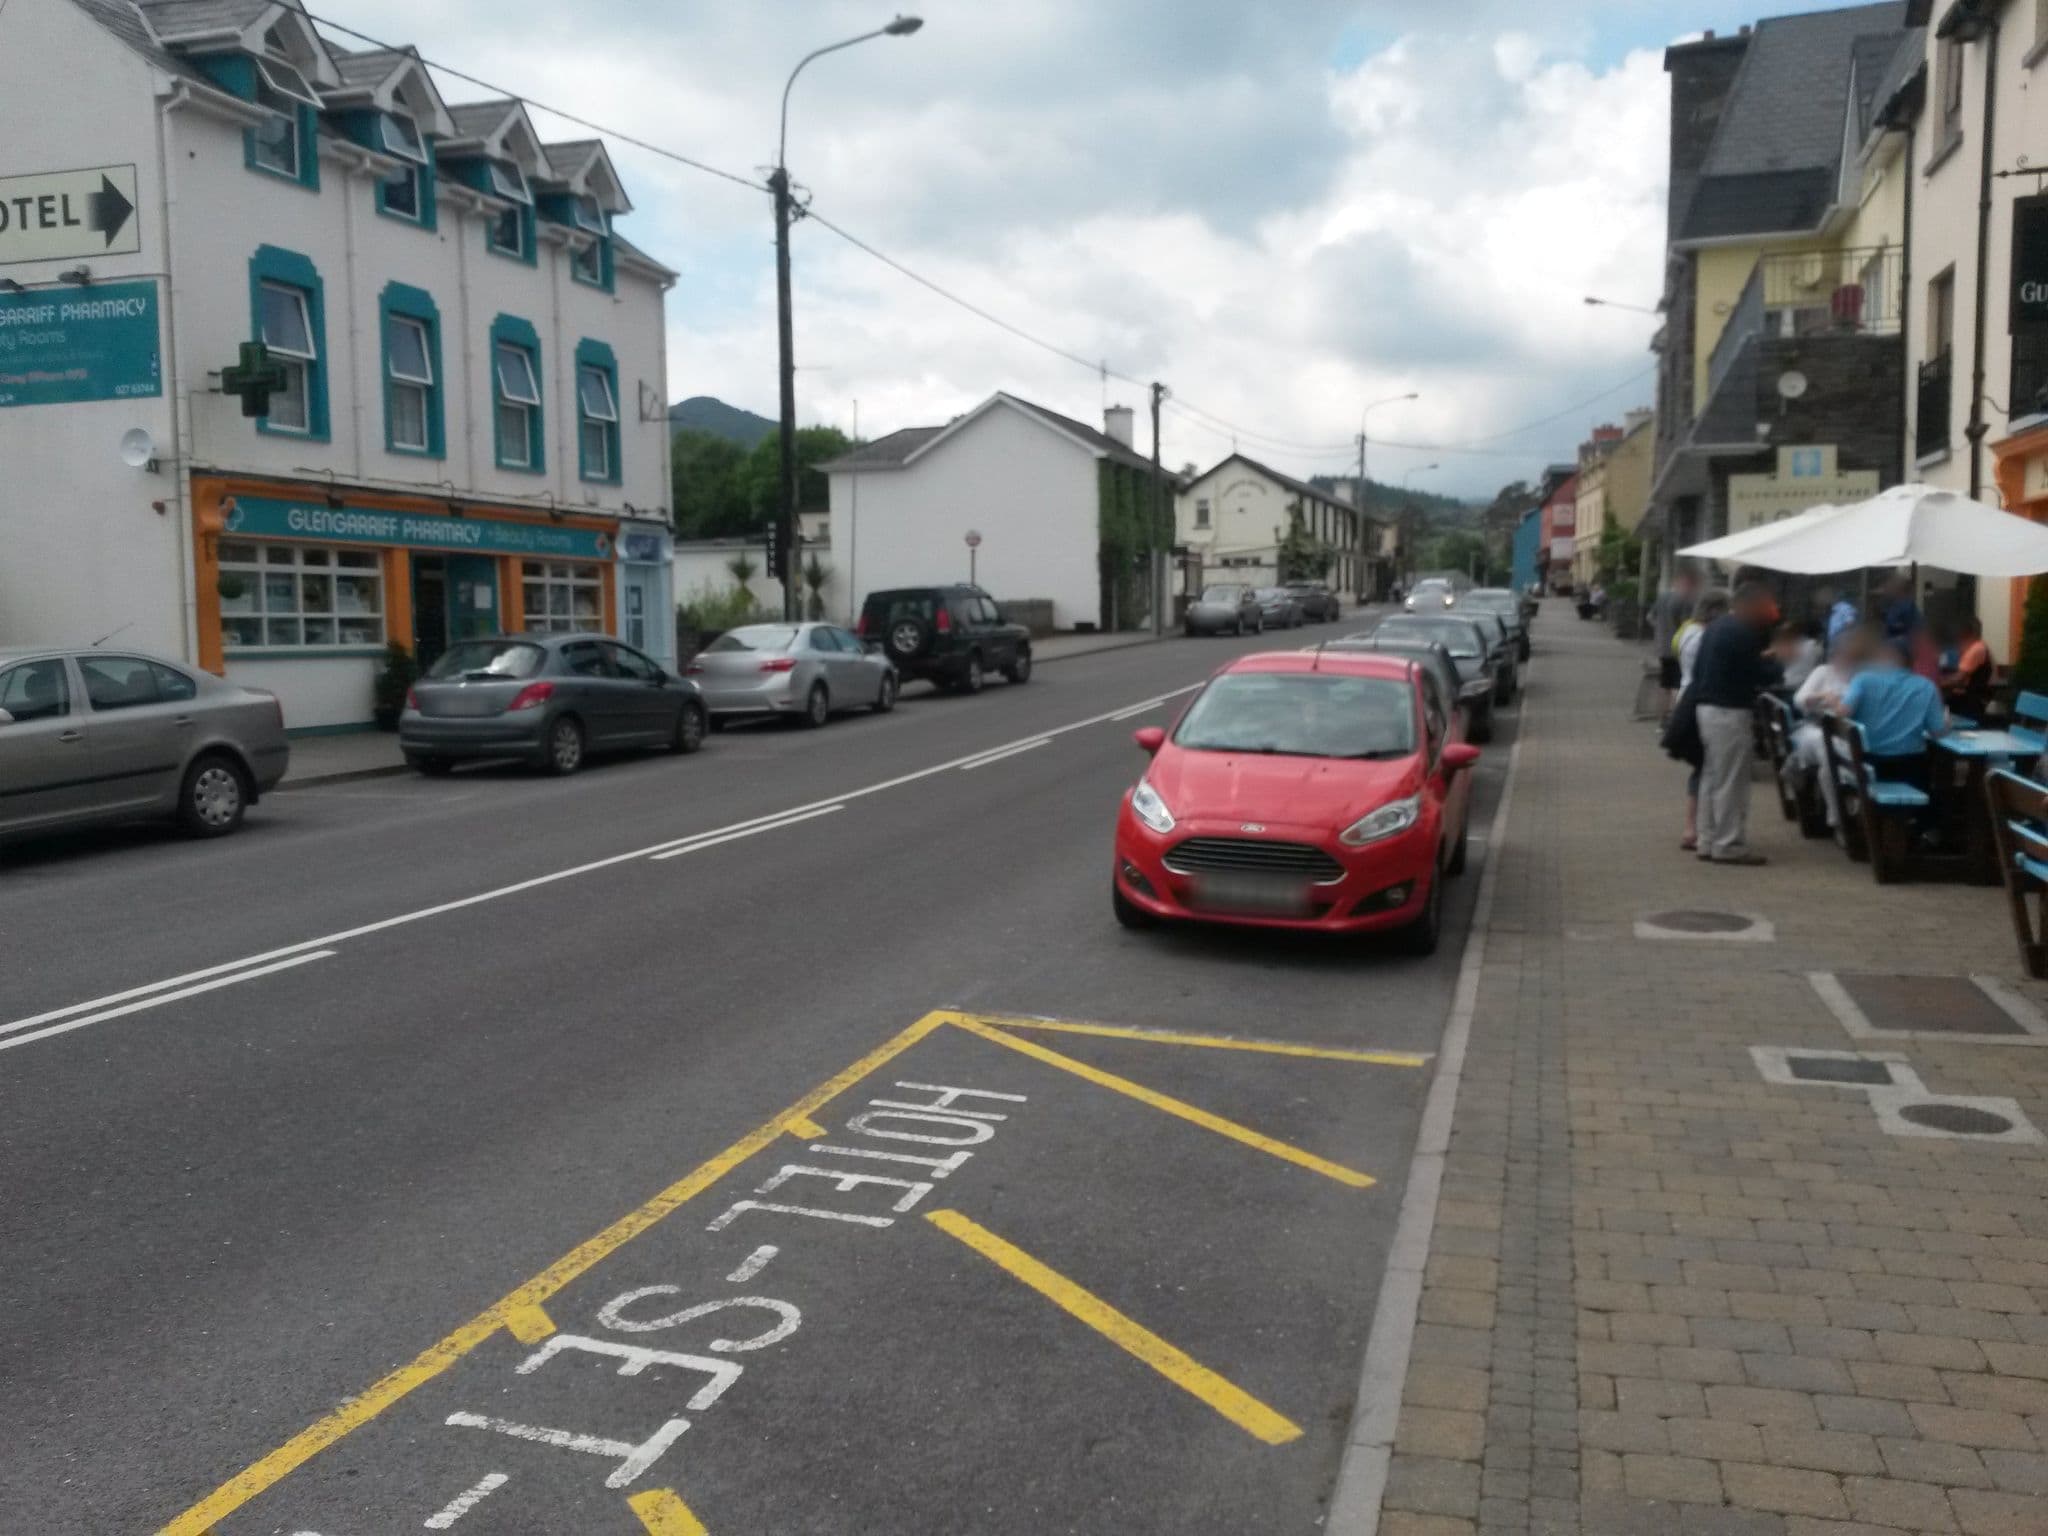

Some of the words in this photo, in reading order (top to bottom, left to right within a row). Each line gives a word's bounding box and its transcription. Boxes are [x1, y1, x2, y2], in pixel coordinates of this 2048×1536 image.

[61, 298, 145, 321] PHARMACY
[287, 509, 398, 537] GLENGARRIFF
[402, 519, 481, 545] PHARMACY
